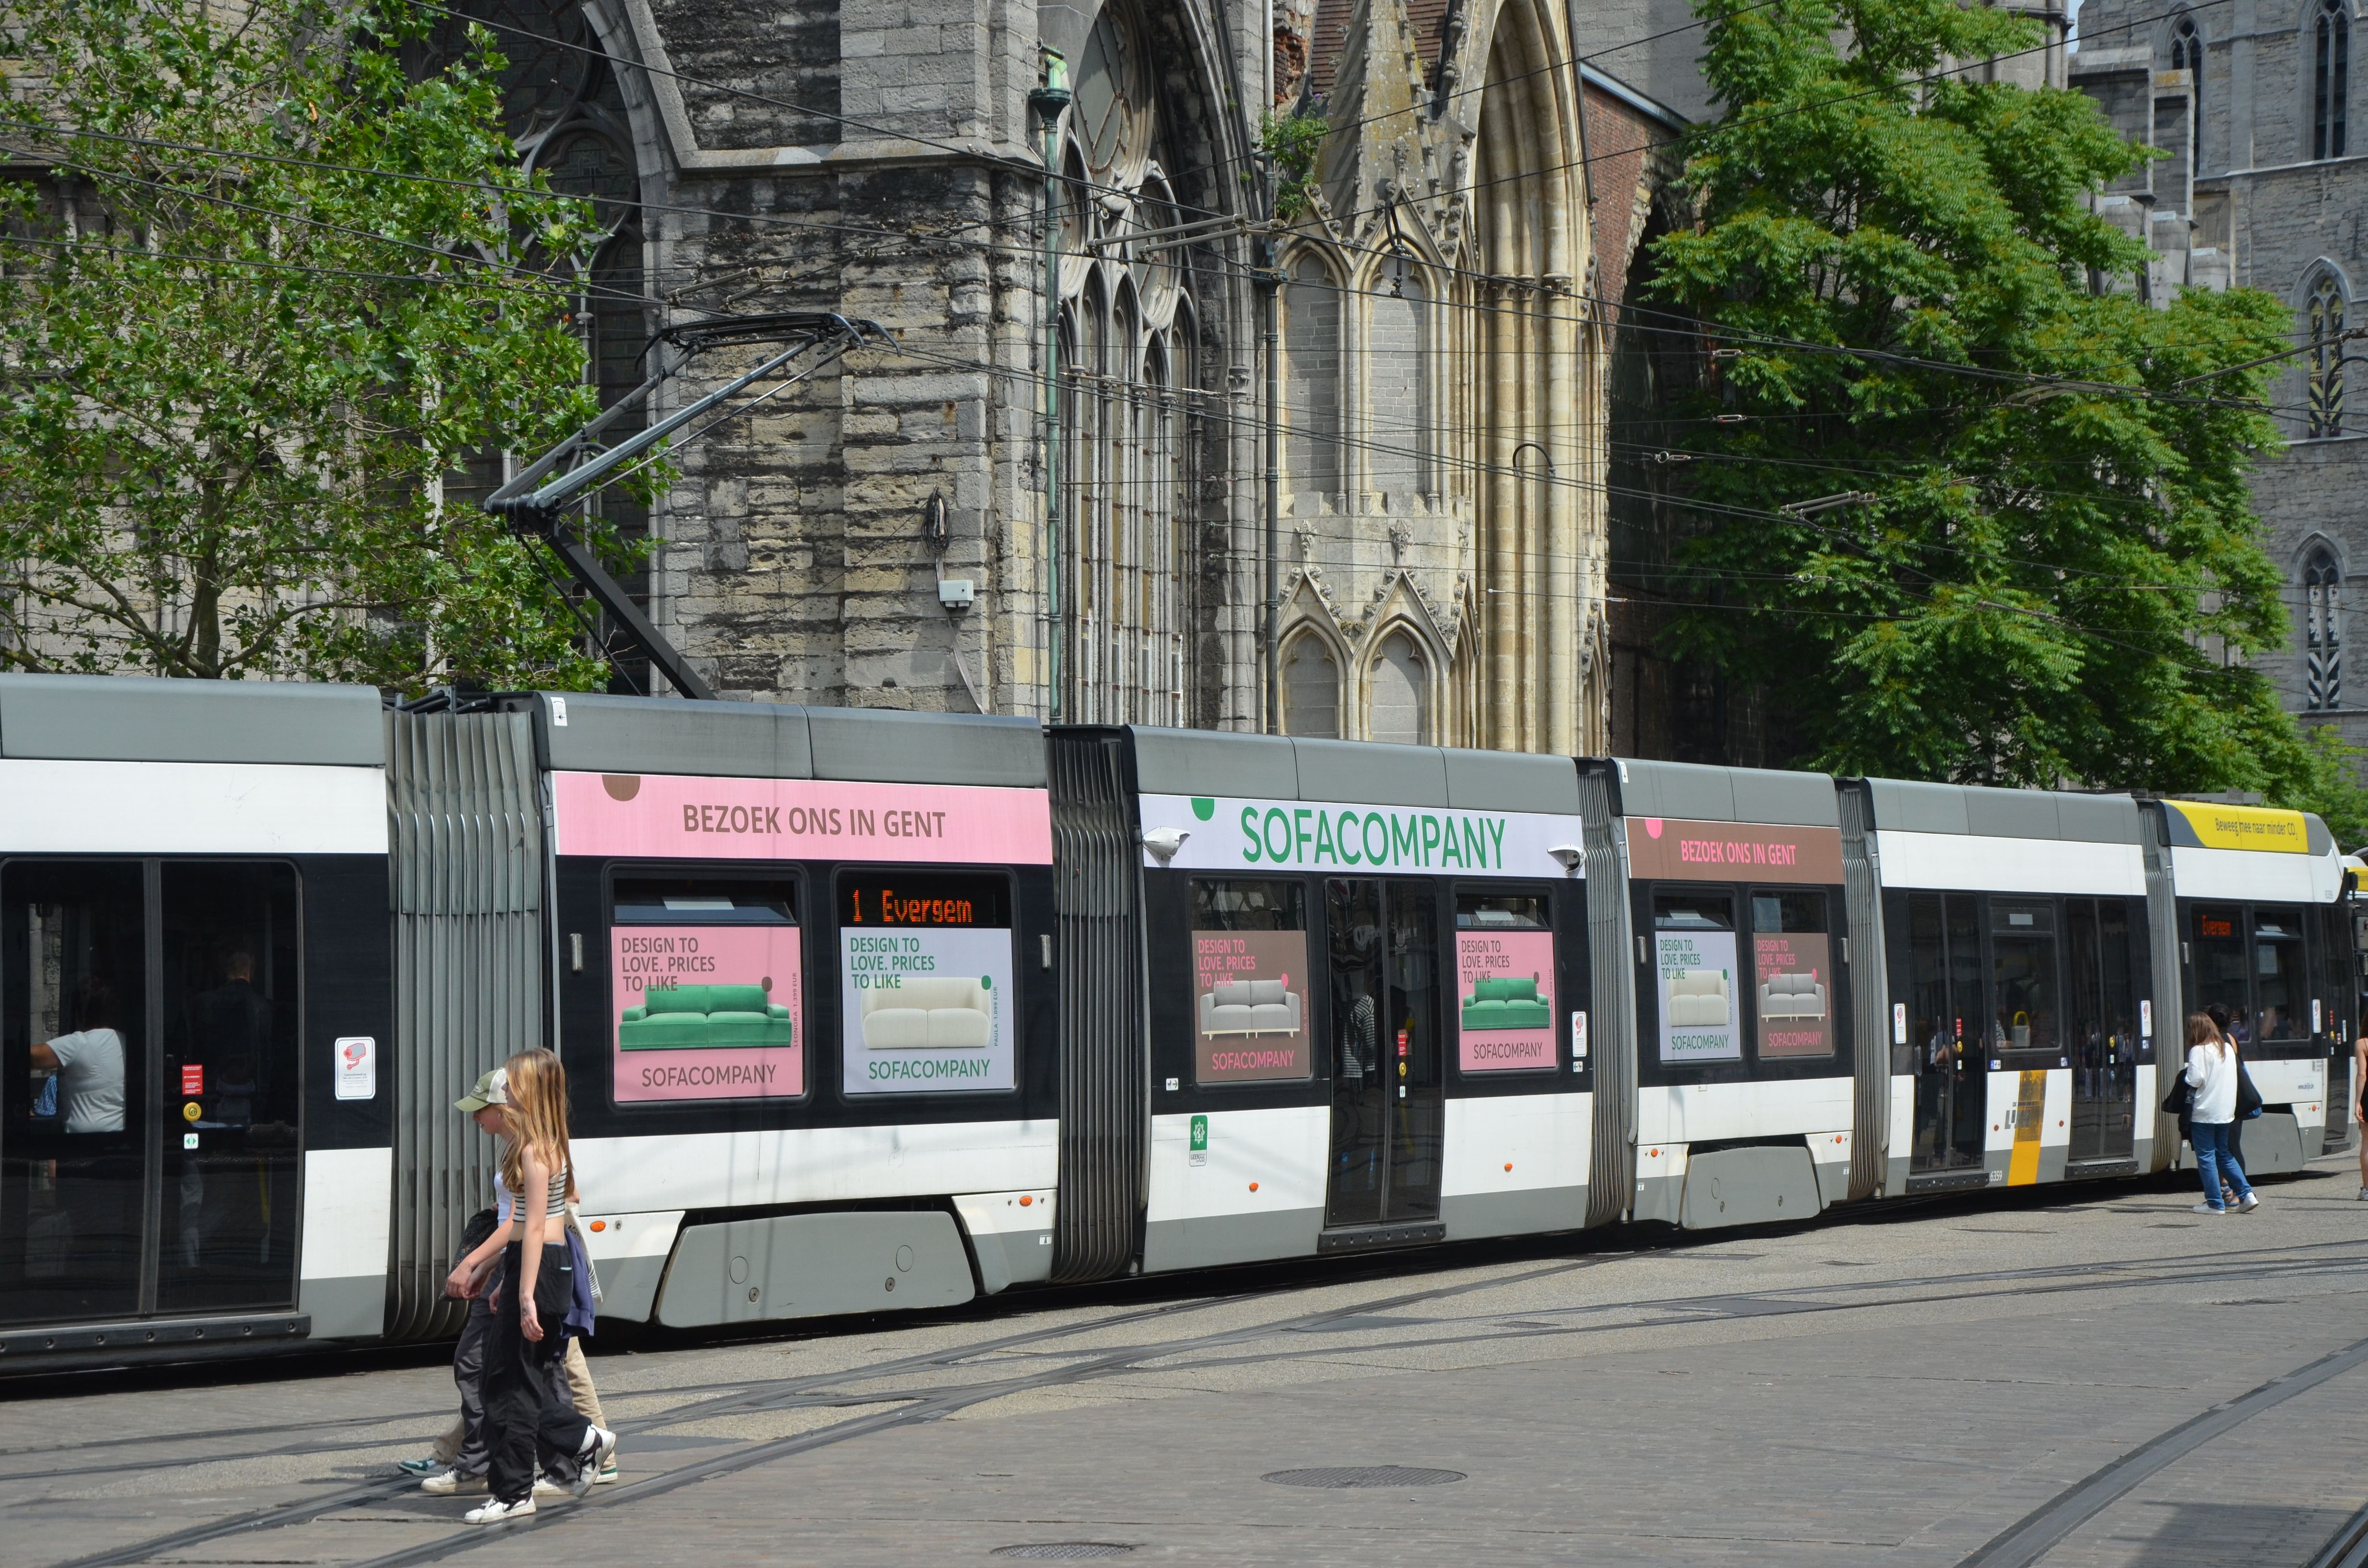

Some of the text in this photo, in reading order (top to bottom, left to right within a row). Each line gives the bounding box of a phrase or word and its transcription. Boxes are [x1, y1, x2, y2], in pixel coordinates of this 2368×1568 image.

[683, 804, 946, 838] BEZOEK ONS IN GENT
[2215, 818, 2239, 836] Beweeg
[2240, 821, 2251, 833] mee
[2253, 823, 2265, 833] naar
[2267, 821, 2285, 834] minder
[1241, 807, 1505, 870] SOFACOMPANY
[1681, 840, 1796, 865] BEZOEK ONS IN GENT
[853, 890, 972, 922] 1 Evergem
[622, 937, 698, 953] DESIGN TO
[850, 937, 920, 952] DESIGN TO
[1198, 939, 1245, 954] DESIGN TO
[1461, 940, 1501, 953] DESIGN TO
[1660, 940, 1692, 951] DESIGN TO
[1757, 940, 1788, 951] DESIGN TO
[622, 956, 715, 972] LOVE. PRICES
[851, 956, 935, 970] LOVE. PRICES
[1199, 956, 1256, 970] LOVE. PRICES
[1462, 956, 1510, 968] LOVE. PRICES
[1661, 954, 1700, 965] LOVE. PRICES
[1758, 954, 1795, 965] LOVE. PRICES
[1200, 973, 1233, 987] TO LIKE
[1463, 971, 1491, 983] TO LIKE
[1662, 968, 1685, 980] TO LIKE
[1759, 968, 1781, 979] TO LIKE
[623, 976, 678, 992] TO LIKE
[852, 974, 901, 989] TO LIKE
[1672, 1034, 1729, 1050] SOFACOMPANY
[1769, 1032, 1822, 1047] SOFACOMPANY
[1474, 1042, 1542, 1059] SOFACOMPANY
[1212, 1050, 1294, 1070] SOFACOMPANY
[642, 1064, 777, 1087] SOFACOMPANY
[869, 1059, 990, 1079] SOFACOMPANY
[1990, 1171, 2002, 1181] 6359
